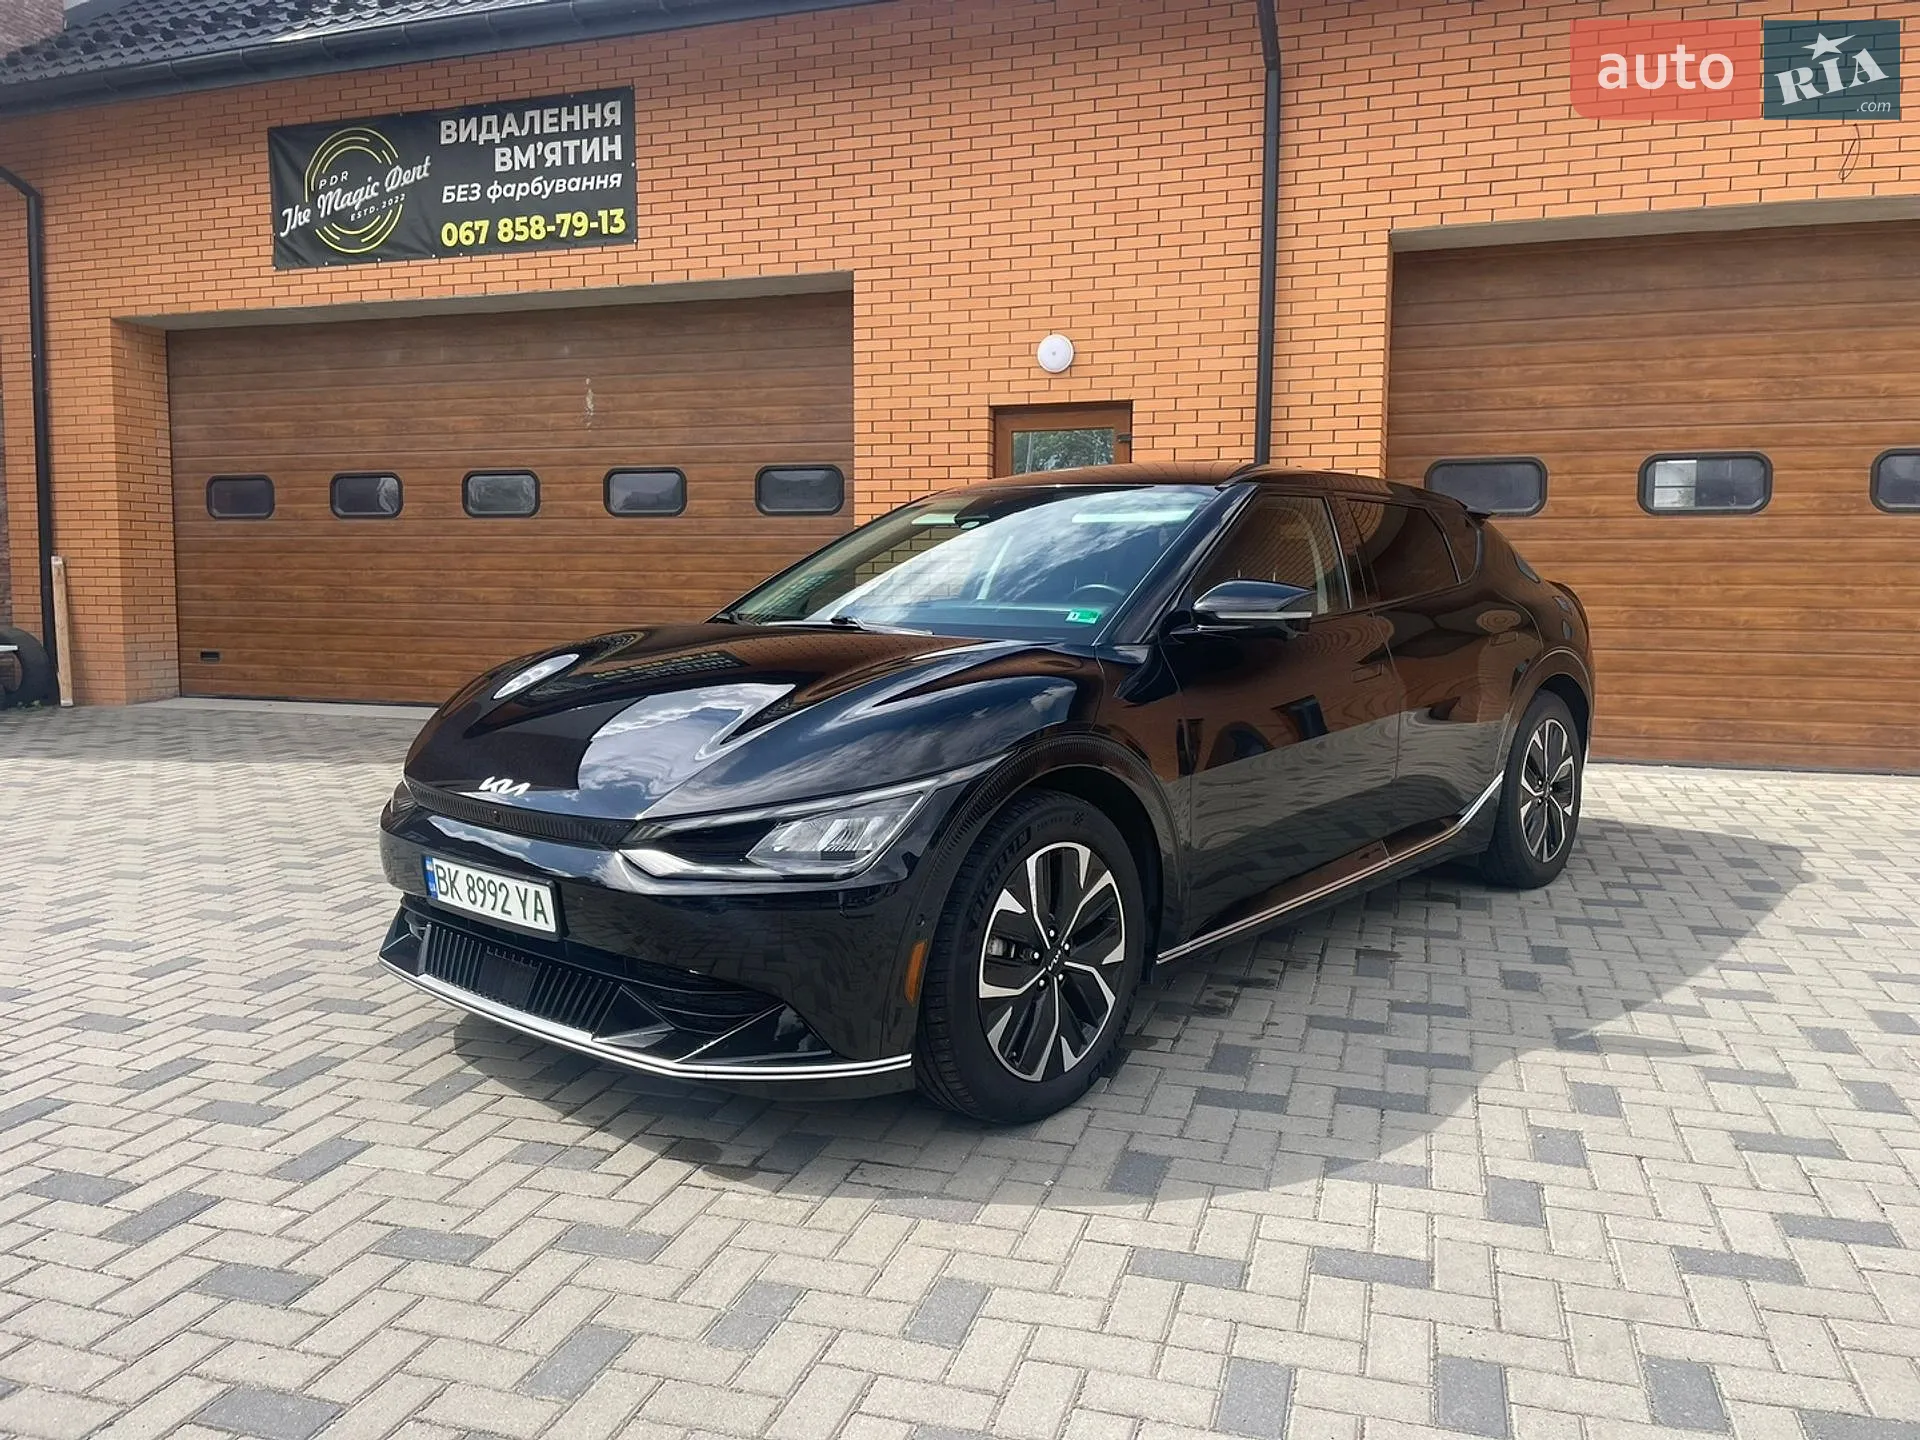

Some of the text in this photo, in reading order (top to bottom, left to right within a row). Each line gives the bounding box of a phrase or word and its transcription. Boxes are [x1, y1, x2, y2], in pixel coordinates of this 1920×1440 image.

[440, 101, 621, 145] ВИДАЛЕННЯ
[279, 155, 431, 238] The Magic Dent
[318, 170, 349, 190] PDR
[442, 173, 622, 204] БЕЗ фарбування
[350, 193, 406, 222] ESTD. 2022
[441, 208, 627, 247] 067 858-79-13
[435, 864, 549, 925] BK 8992 YA
